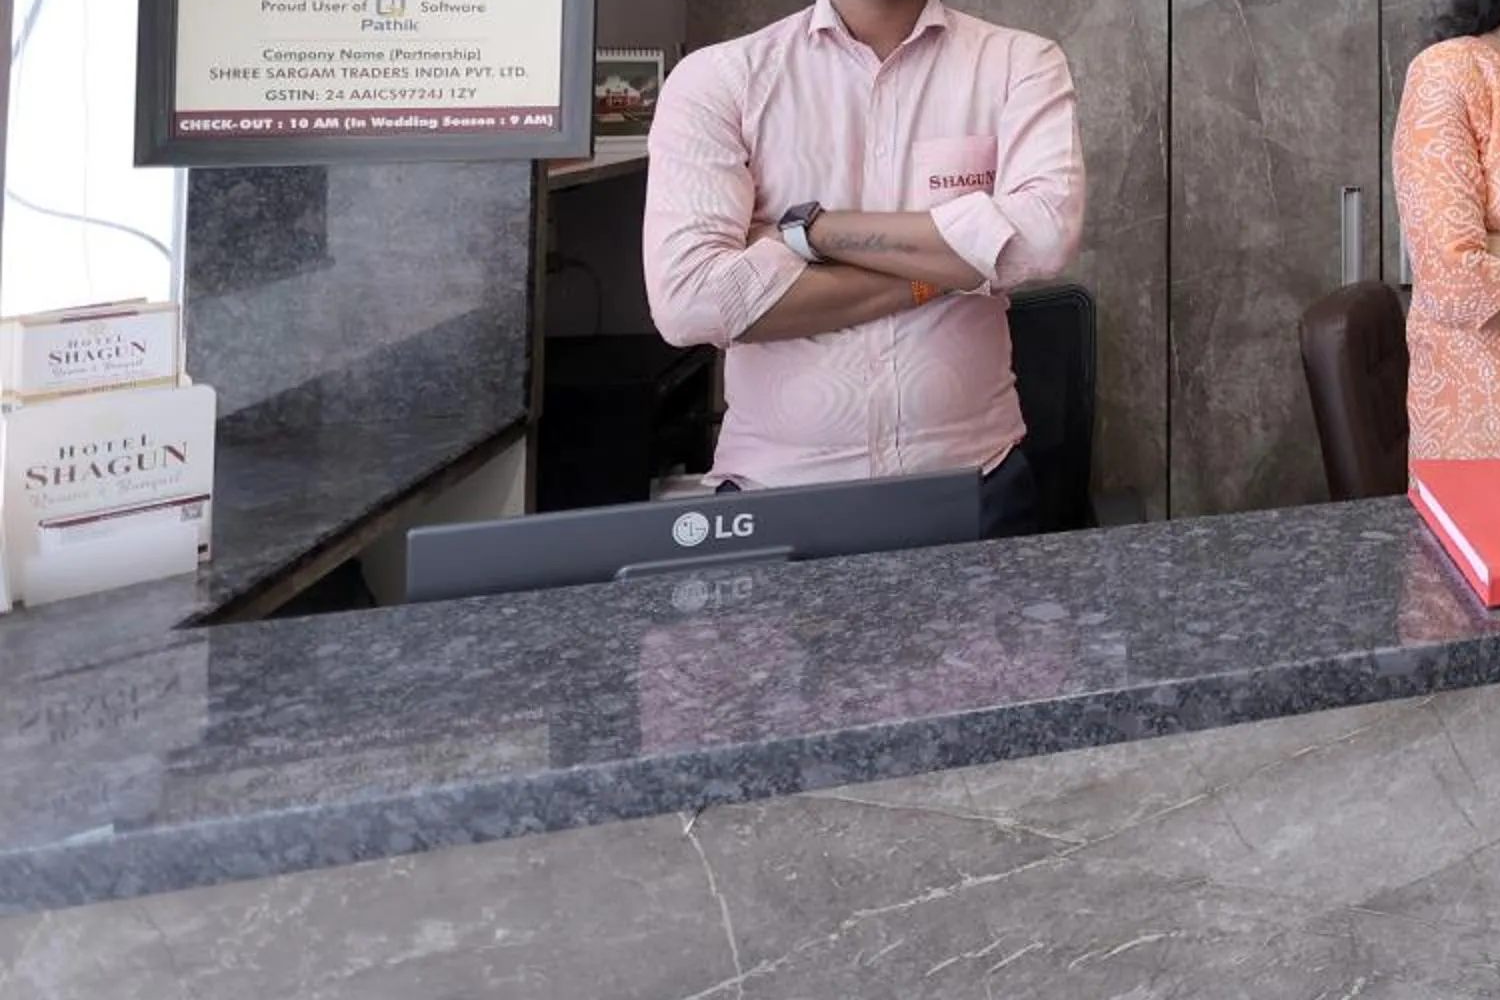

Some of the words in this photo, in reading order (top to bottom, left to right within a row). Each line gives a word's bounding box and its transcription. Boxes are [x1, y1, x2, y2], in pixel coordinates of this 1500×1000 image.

[261, 1, 307, 13] Proud
[312, 1, 347, 12] User
[352, 0, 367, 12] of
[420, 1, 487, 13] Software
[361, 19, 419, 32] Pathik
[263, 49, 335, 62] Company
[340, 49, 384, 60] Name
[209, 67, 261, 80] SHREE
[266, 67, 336, 79] SARGAM
[341, 67, 410, 78] TRADERS
[416, 67, 461, 78] INDIA
[265, 89, 319, 101] GSTIN:
[326, 89, 345, 100] 24
[451, 88, 477, 99] 1ZY
[180, 119, 273, 131] CHECK-OUT
[291, 118, 309, 129] 10
[313, 117, 340, 129] AM
[345, 117, 366, 130] (In
[371, 116, 439, 129] Wedding
[442, 115, 495, 127] Season
[509, 115, 520, 126] 9
[523, 114, 553, 127] AM)
[928, 169, 996, 190] SHAGUN
[49, 340, 147, 365] SHAGUN
[59, 433, 151, 460] HOTEL
[25, 441, 188, 490] SHAGUN
[715, 513, 755, 539] LG
